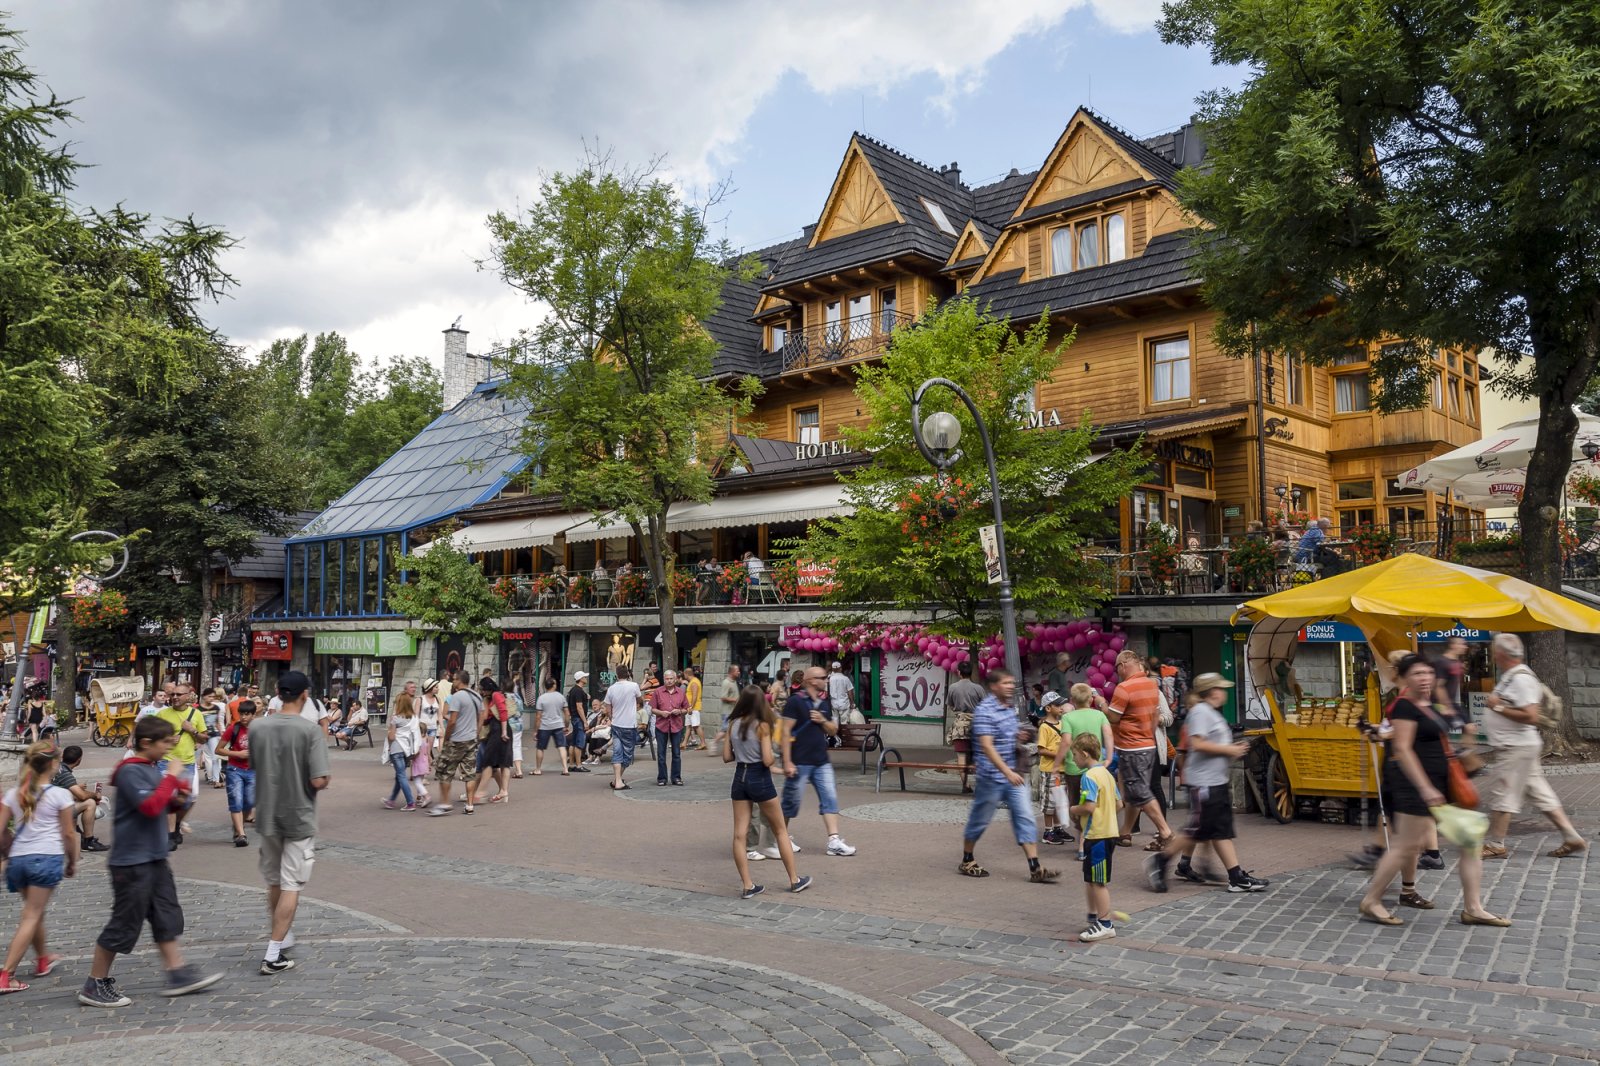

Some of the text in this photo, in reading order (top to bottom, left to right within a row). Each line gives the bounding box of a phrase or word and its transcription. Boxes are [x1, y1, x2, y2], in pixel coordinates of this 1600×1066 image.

[796, 438, 852, 460] HOTEL
[502, 631, 534, 640] house
[1306, 624, 1335, 633] BONUS
[317, 636, 361, 650] DROGERIA
[891, 675, 941, 712] -50%
